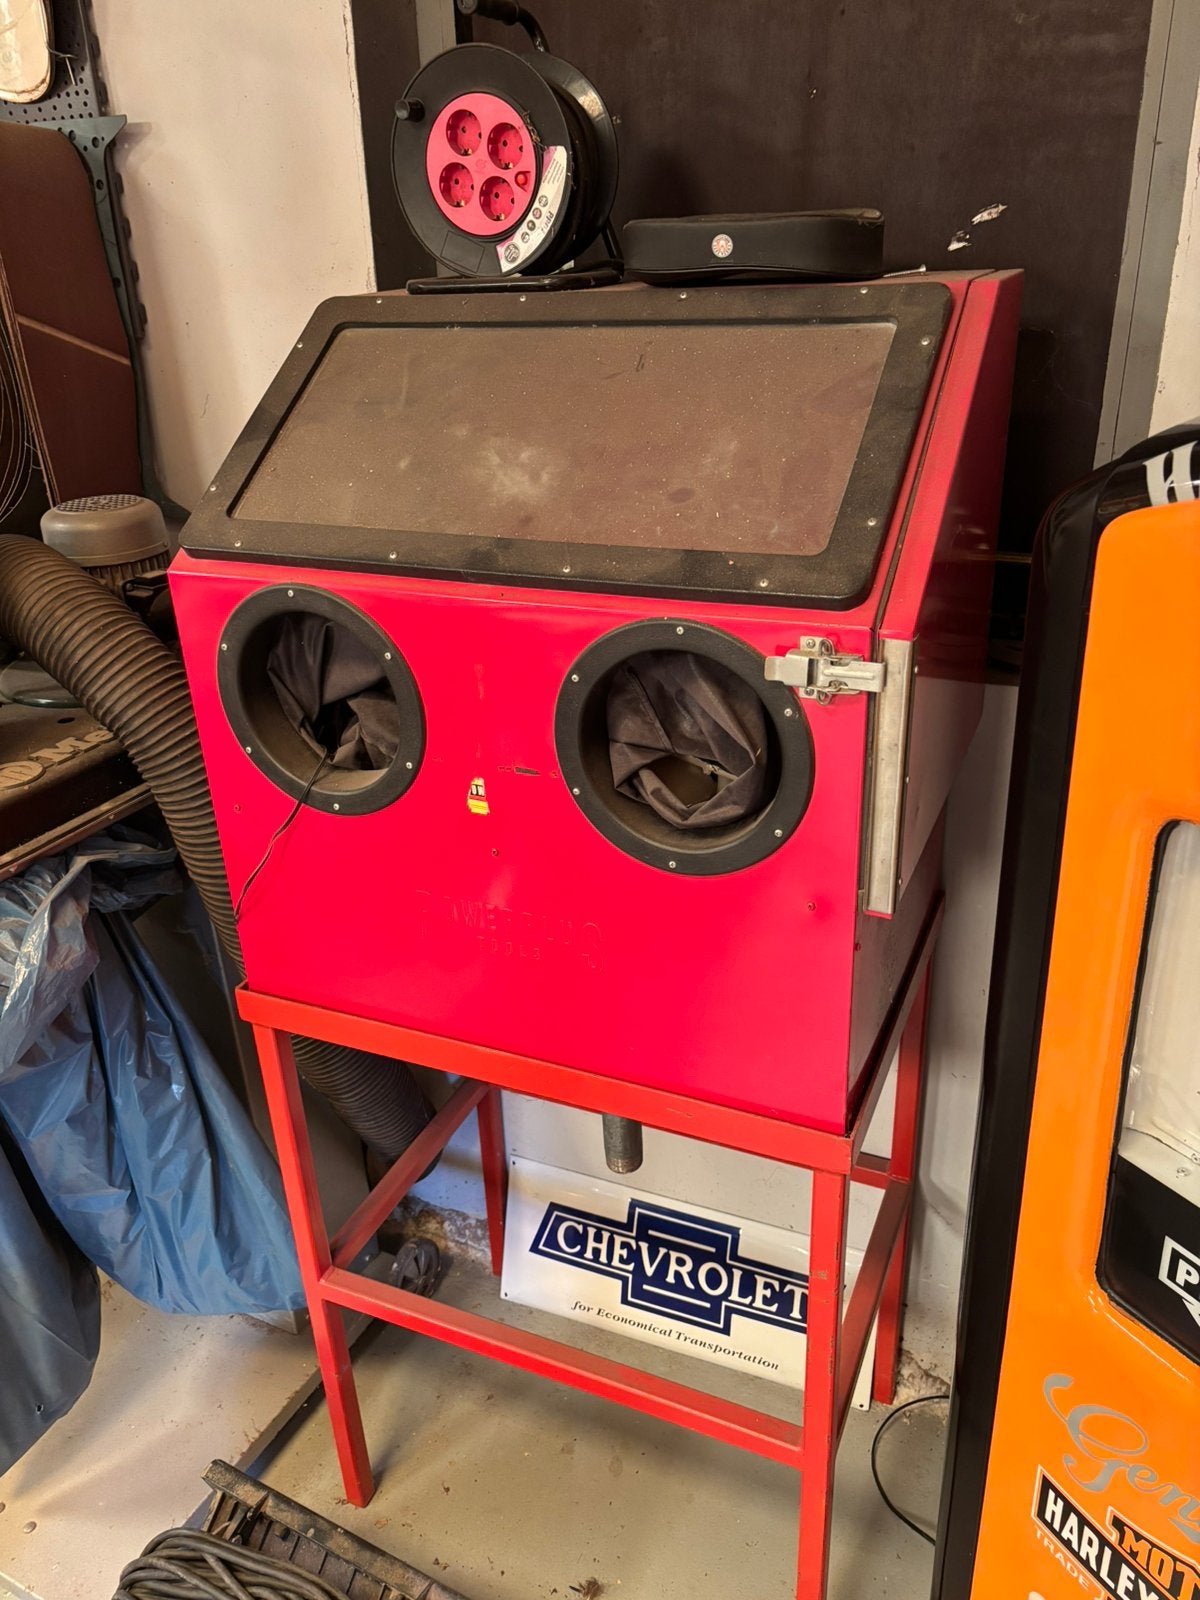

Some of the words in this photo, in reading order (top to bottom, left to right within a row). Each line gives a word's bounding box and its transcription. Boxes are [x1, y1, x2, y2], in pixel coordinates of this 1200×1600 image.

[556, 1219, 810, 1320] CHEVROLET
[571, 1300, 594, 1314] for
[596, 1306, 673, 1338] Economical
[674, 1331, 779, 1371] Transportation
[1034, 1525, 1091, 1591] TRADE
